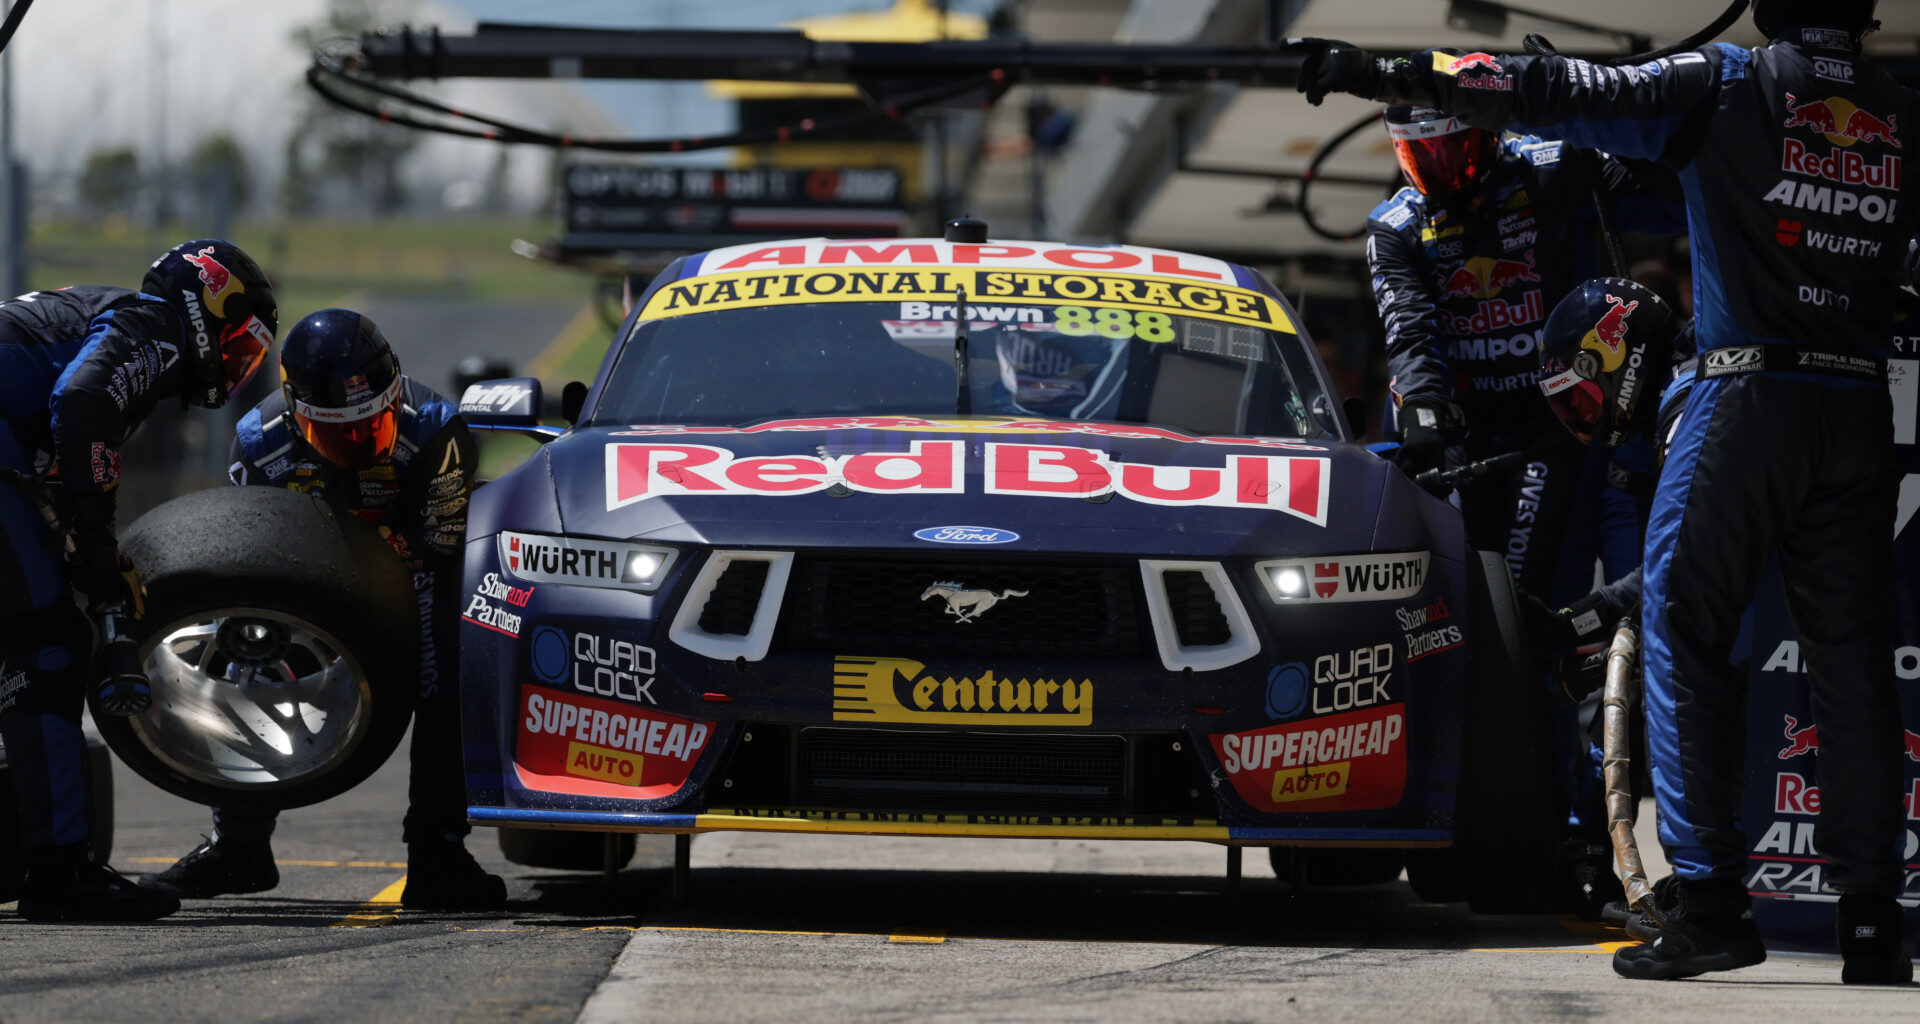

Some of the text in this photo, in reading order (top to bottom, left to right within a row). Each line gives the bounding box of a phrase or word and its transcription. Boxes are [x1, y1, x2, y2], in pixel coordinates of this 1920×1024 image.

[1814, 60, 1853, 79] OMP
[1420, 126, 1436, 134] Dan
[1533, 151, 1558, 162] OMP
[1502, 230, 1538, 250] Thrifty
[1806, 229, 1883, 258] WÜRTH
[715, 244, 1222, 280] AMPOL
[663, 272, 1261, 320] NATIONAL STORAGE
[182, 289, 211, 359] AMPOL
[900, 301, 1044, 322] Brown
[1055, 305, 1176, 343] 888
[1617, 343, 1646, 411] AMPOL
[1739, 363, 1762, 372] WEAR
[1812, 352, 1877, 368] TRIPLE EIGHT
[1548, 377, 1571, 390] AMPOL
[315, 411, 345, 419] AMPOL
[357, 404, 373, 415] Joel
[265, 459, 288, 477] OMP
[430, 467, 465, 486] AMPOL
[605, 440, 1331, 528] Red Bull
[1515, 461, 1549, 524] GIVES
[934, 528, 1000, 542] Ford
[522, 543, 617, 578] WÜRTH
[1344, 558, 1422, 592] WÜRTH
[477, 572, 534, 608] Shaw and
[463, 594, 521, 635] Partners
[1396, 605, 1427, 632] Shaw
[575, 632, 656, 675] QUAD
[1405, 625, 1463, 659] Partners
[1314, 643, 1393, 684] QUAD
[575, 661, 657, 706] LOCK
[833, 655, 1093, 727] Century
[1312, 673, 1392, 715] LOCK
[525, 693, 708, 762] SUPERCHEAP
[1222, 714, 1402, 774] SUPERCHEAP
[573, 751, 634, 777] AUTO
[1279, 770, 1340, 795] AUTO
